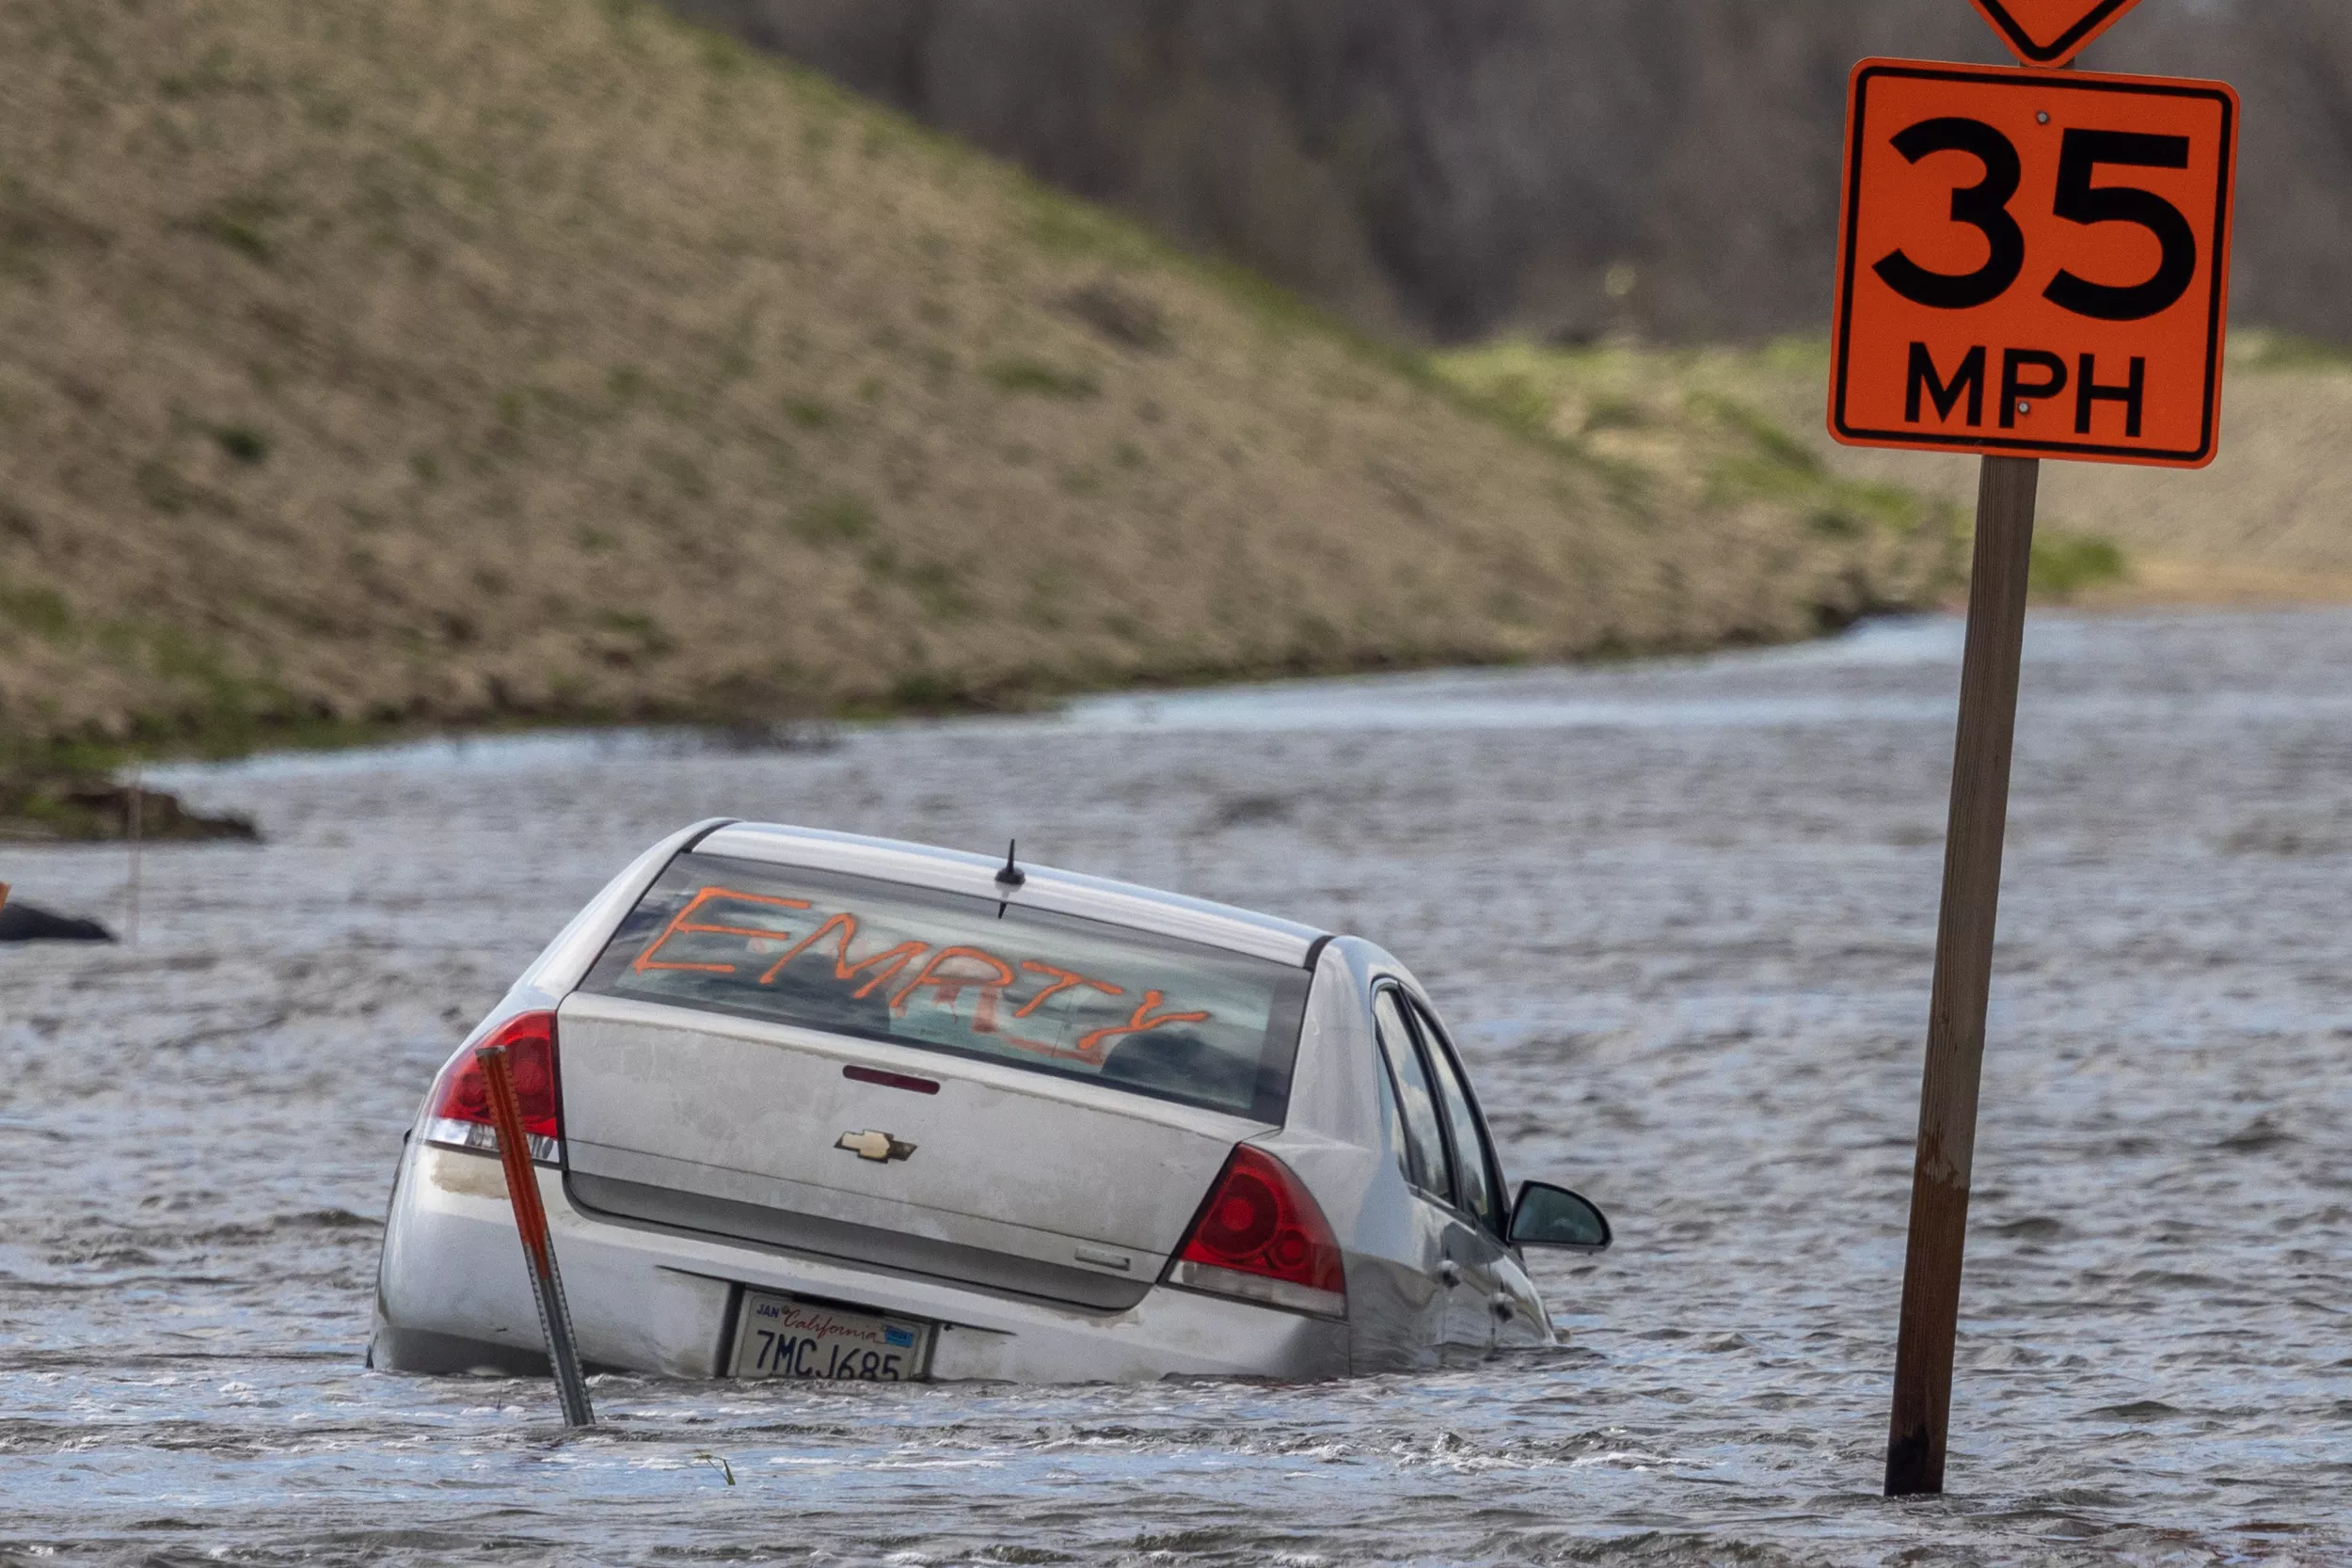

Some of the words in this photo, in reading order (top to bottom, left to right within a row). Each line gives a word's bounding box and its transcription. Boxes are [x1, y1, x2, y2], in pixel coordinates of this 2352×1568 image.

[1870, 117, 2197, 321] 35
[1904, 341, 2146, 437] MPH
[634, 886, 1209, 1050] EMPTY
[756, 1304, 780, 1319] JAN
[783, 1308, 884, 1344] California
[756, 1329, 901, 1381] 7MCJ685
